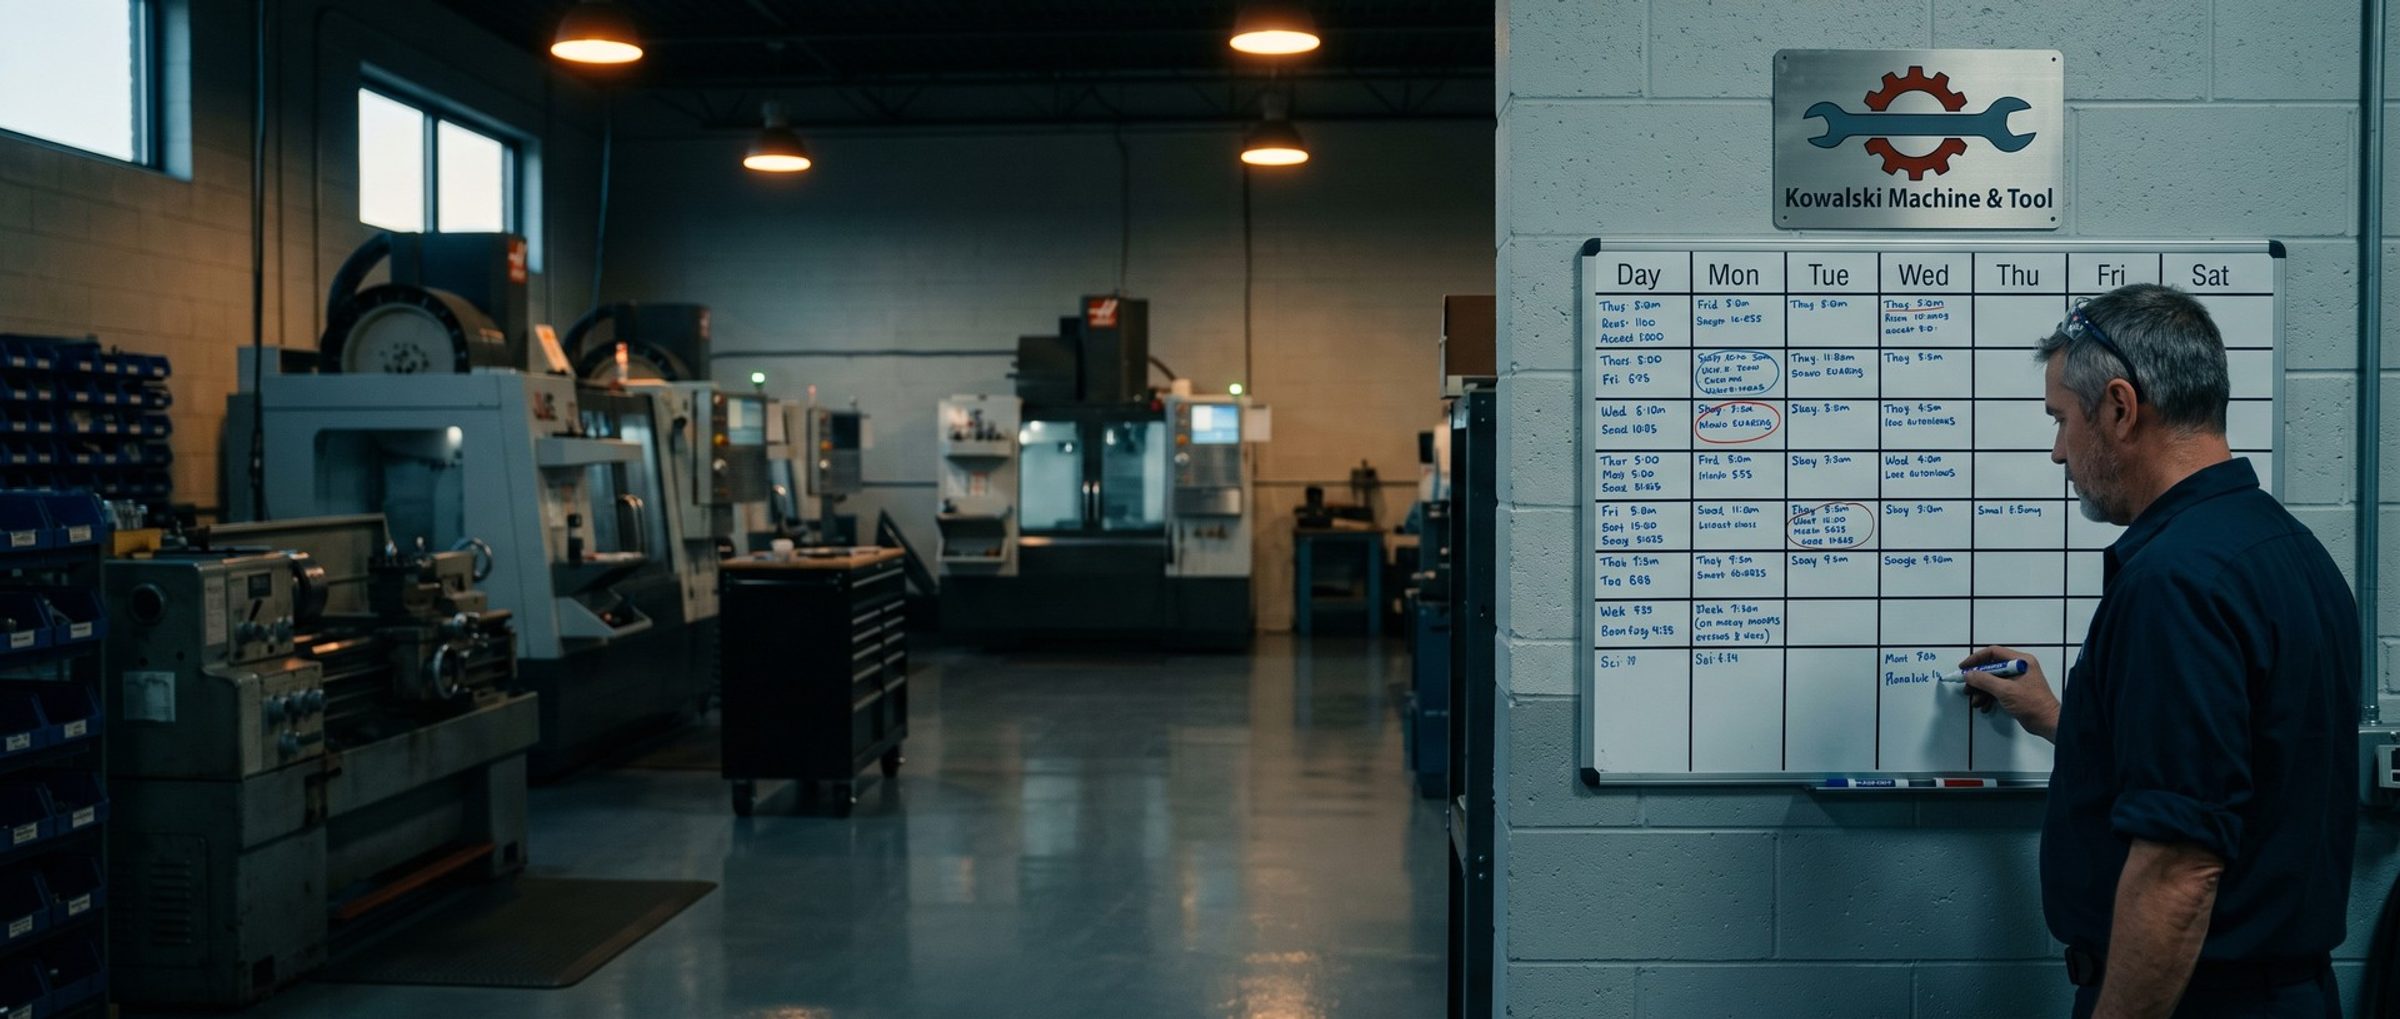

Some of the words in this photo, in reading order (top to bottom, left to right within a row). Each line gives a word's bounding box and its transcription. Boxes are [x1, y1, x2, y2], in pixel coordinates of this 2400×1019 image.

[1785, 187, 1882, 208] Kowalski
[1889, 187, 1981, 208] Machine
[1987, 188, 2003, 208] &
[2010, 187, 2053, 208] Tool
[1616, 264, 1661, 290] Day
[1708, 263, 1760, 287] Mon
[1808, 263, 1850, 287] Tue
[1898, 263, 1950, 287] Wed
[1996, 263, 2039, 287] Thu
[2097, 263, 2126, 287] Fri
[2191, 263, 2230, 287] Sat
[1602, 505, 1619, 517] Fri
